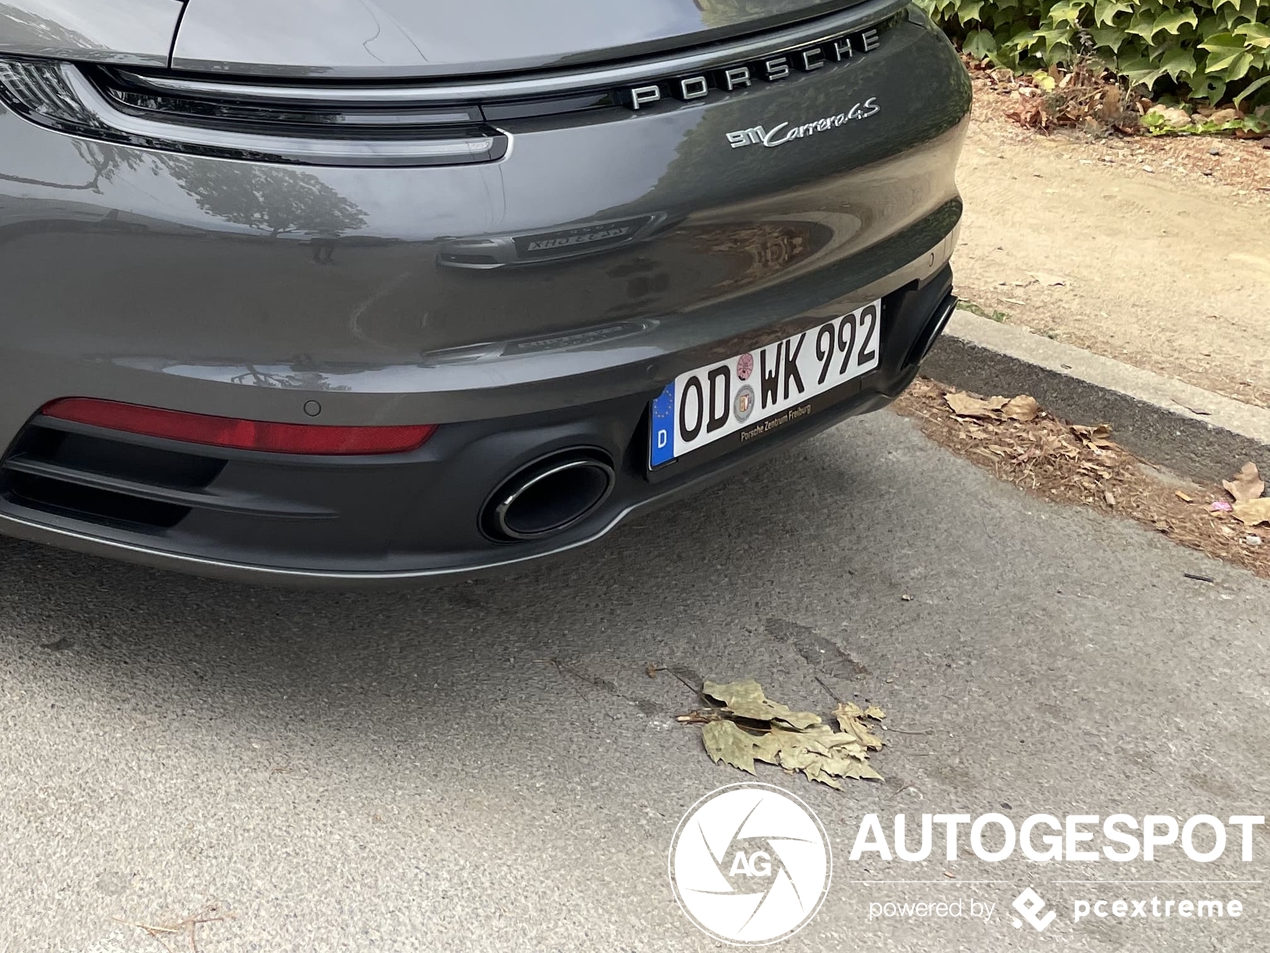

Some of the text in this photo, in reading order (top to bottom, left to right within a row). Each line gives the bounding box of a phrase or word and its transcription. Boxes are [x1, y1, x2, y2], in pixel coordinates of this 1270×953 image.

[631, 28, 880, 110] PORSCHE
[726, 125, 765, 148] 911
[763, 113, 848, 147] Carrera
[679, 304, 877, 443] OD WK 992
[657, 428, 668, 449] D
[740, 403, 812, 442] Porsche Zentrum Freiburg
